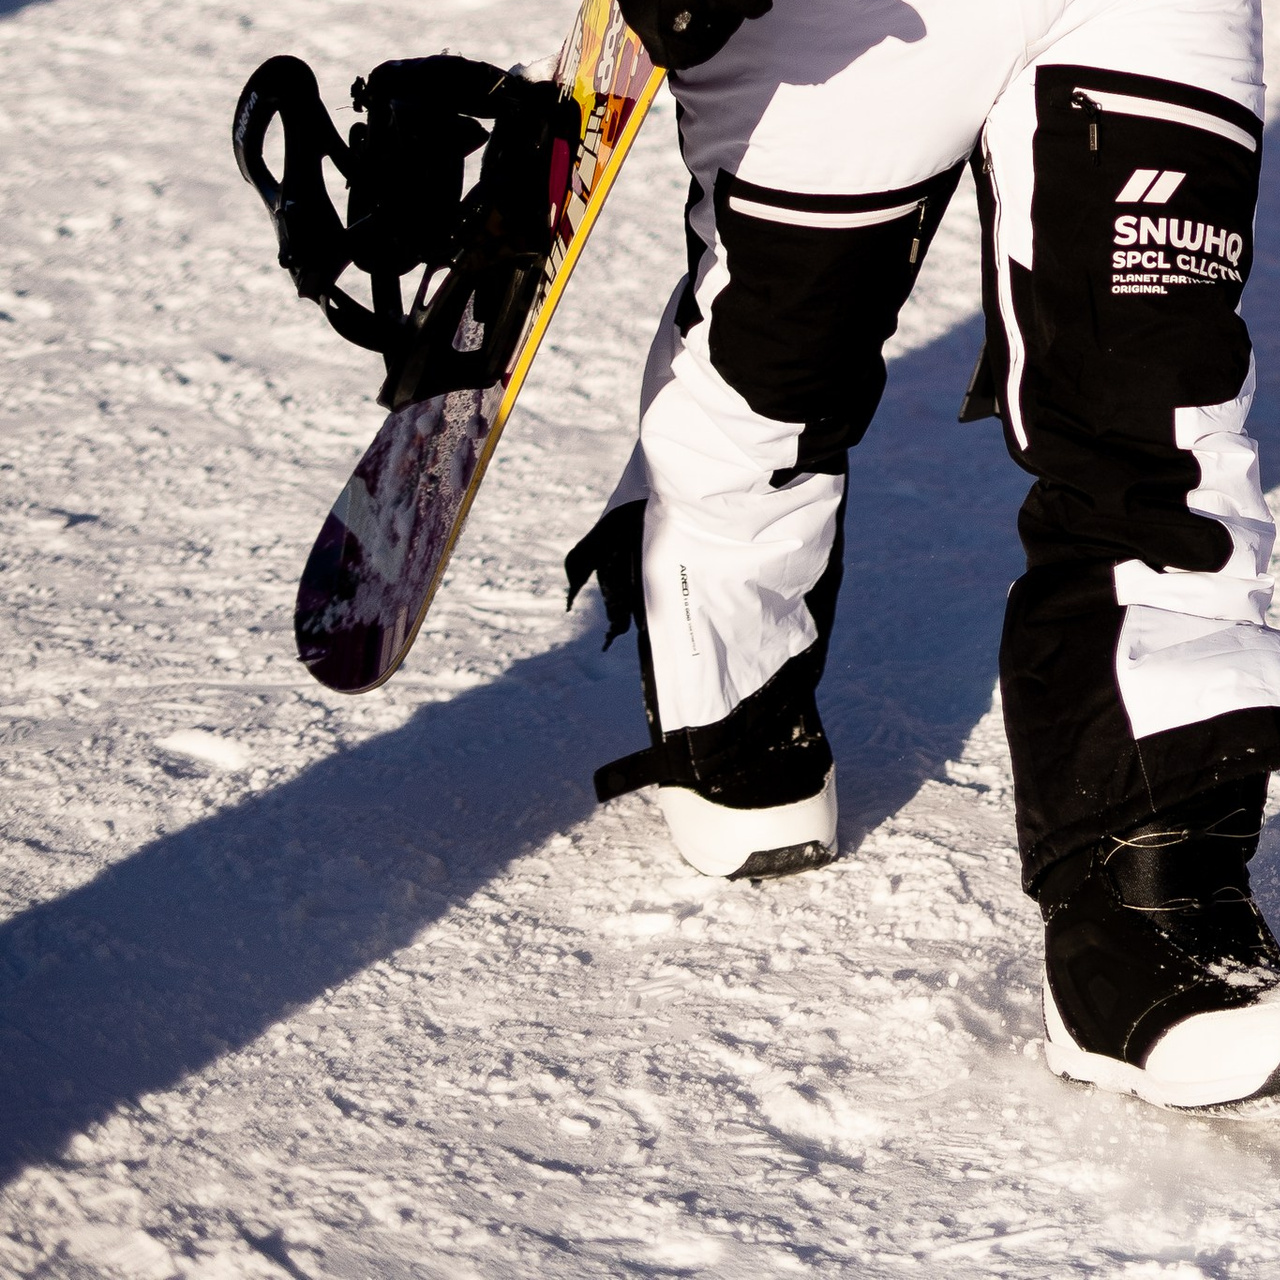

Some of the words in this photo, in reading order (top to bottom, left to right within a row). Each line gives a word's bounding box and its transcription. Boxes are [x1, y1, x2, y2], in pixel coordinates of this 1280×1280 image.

[1113, 214, 1243, 268] SNWHQ
[1112, 250, 1171, 269] SPCL
[1112, 273, 1160, 283] PLANET
[1111, 284, 1168, 295] ORIGINAL
